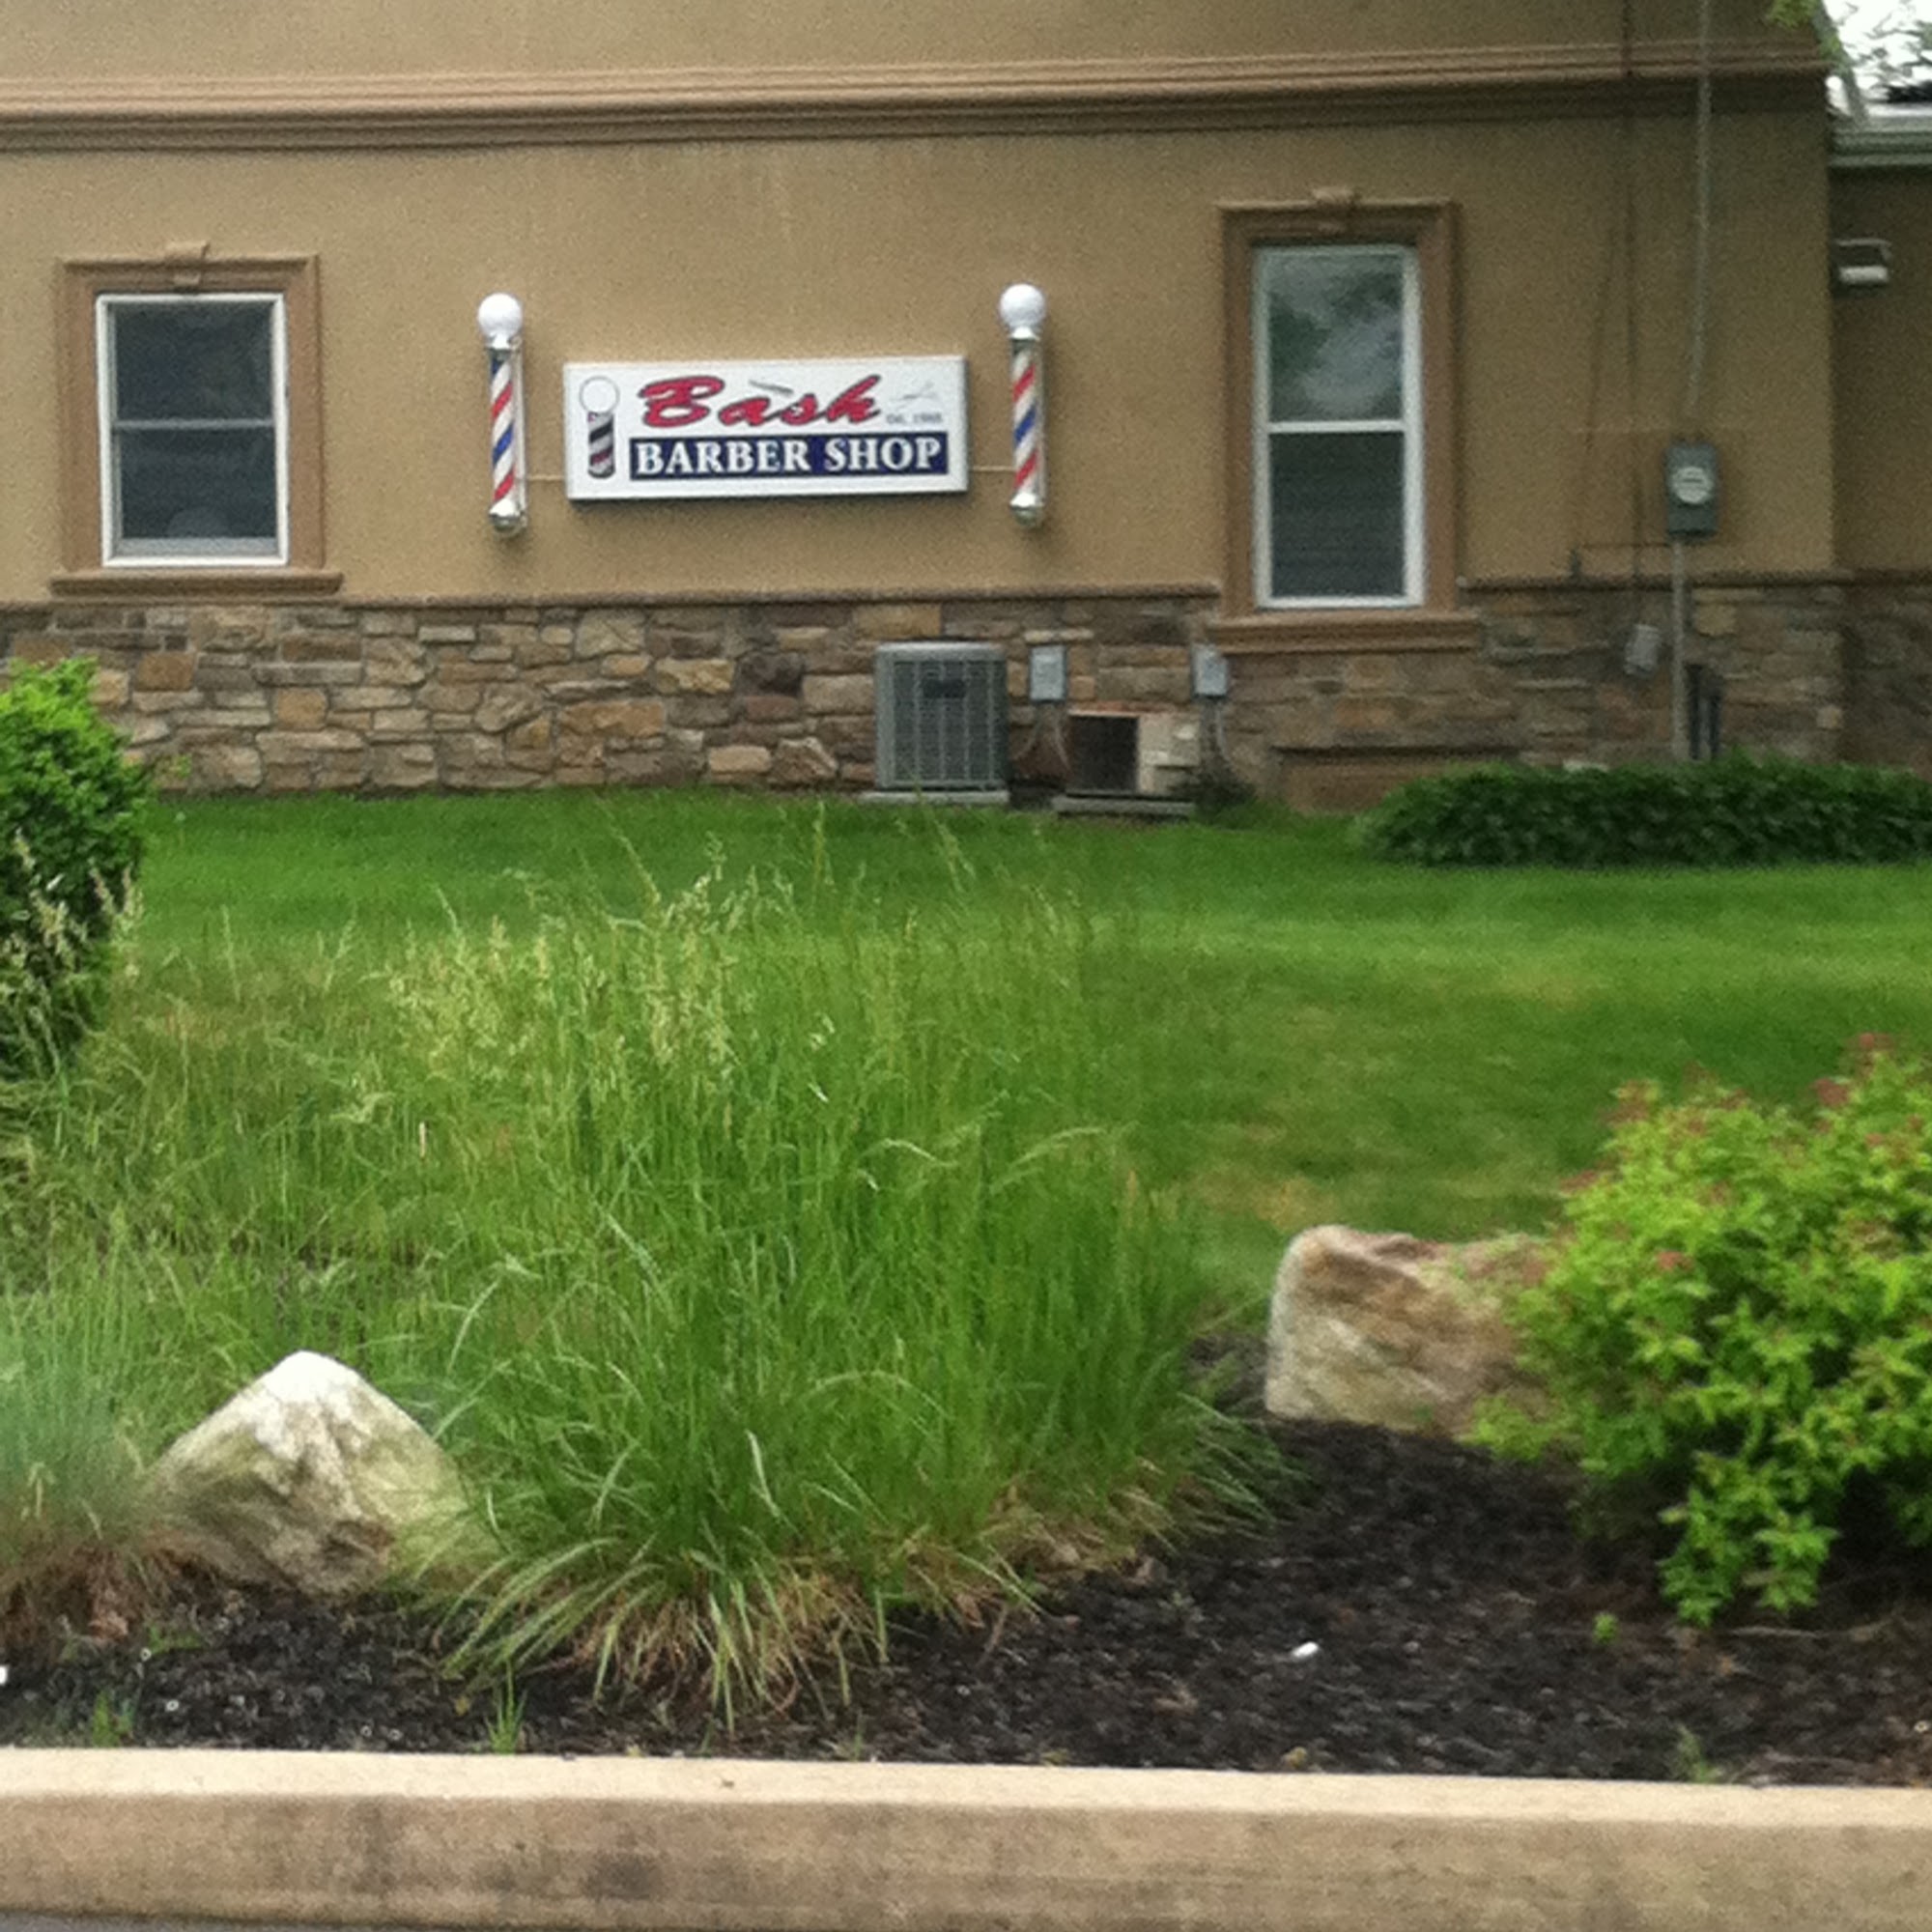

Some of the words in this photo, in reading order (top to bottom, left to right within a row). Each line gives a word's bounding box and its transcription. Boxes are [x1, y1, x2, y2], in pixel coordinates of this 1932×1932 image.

[638, 374, 882, 427] Bash
[636, 439, 811, 474] BARBER
[825, 435, 941, 470] SHOP
